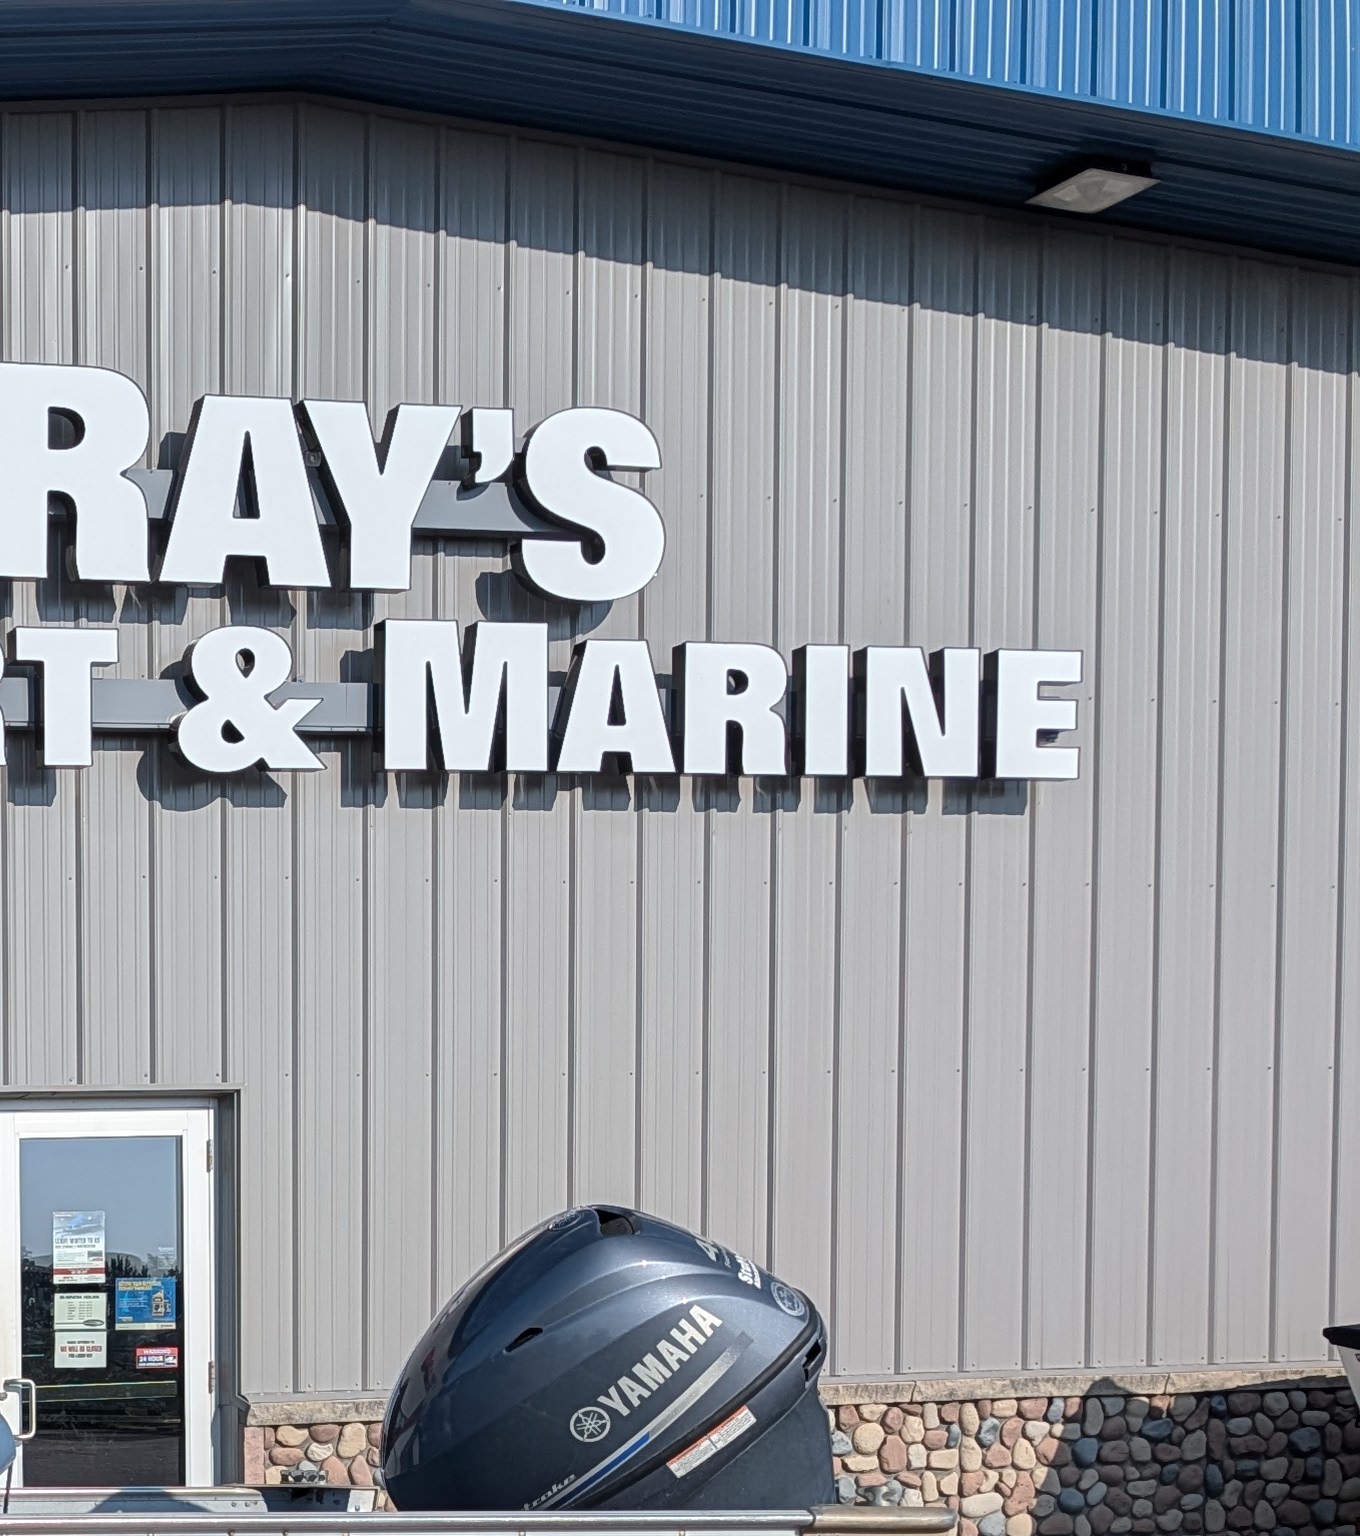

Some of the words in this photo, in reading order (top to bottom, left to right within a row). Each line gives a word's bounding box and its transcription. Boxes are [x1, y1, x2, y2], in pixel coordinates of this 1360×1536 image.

[174, 625, 327, 774] &
[378, 618, 1083, 780] MARINE
[597, 1304, 722, 1416] YAMAHA
